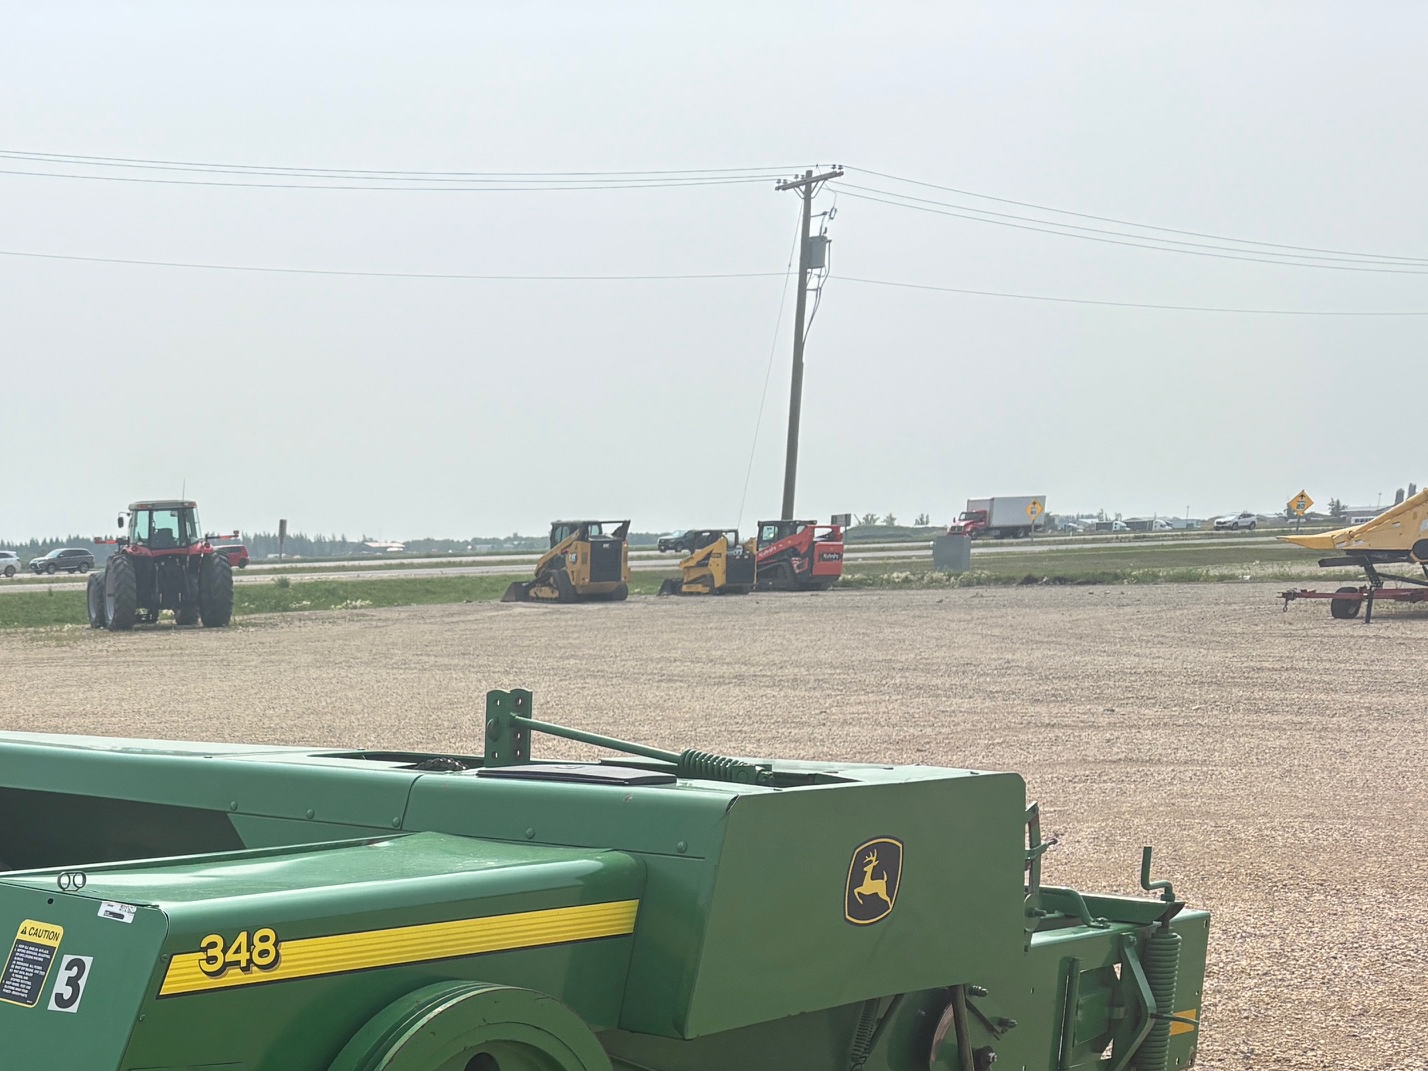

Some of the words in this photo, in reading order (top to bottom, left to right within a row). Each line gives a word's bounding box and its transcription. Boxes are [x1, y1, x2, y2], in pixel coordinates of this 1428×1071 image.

[28, 927, 61, 941] CAUTION
[199, 928, 278, 974] 348
[54, 957, 87, 1009] 3
